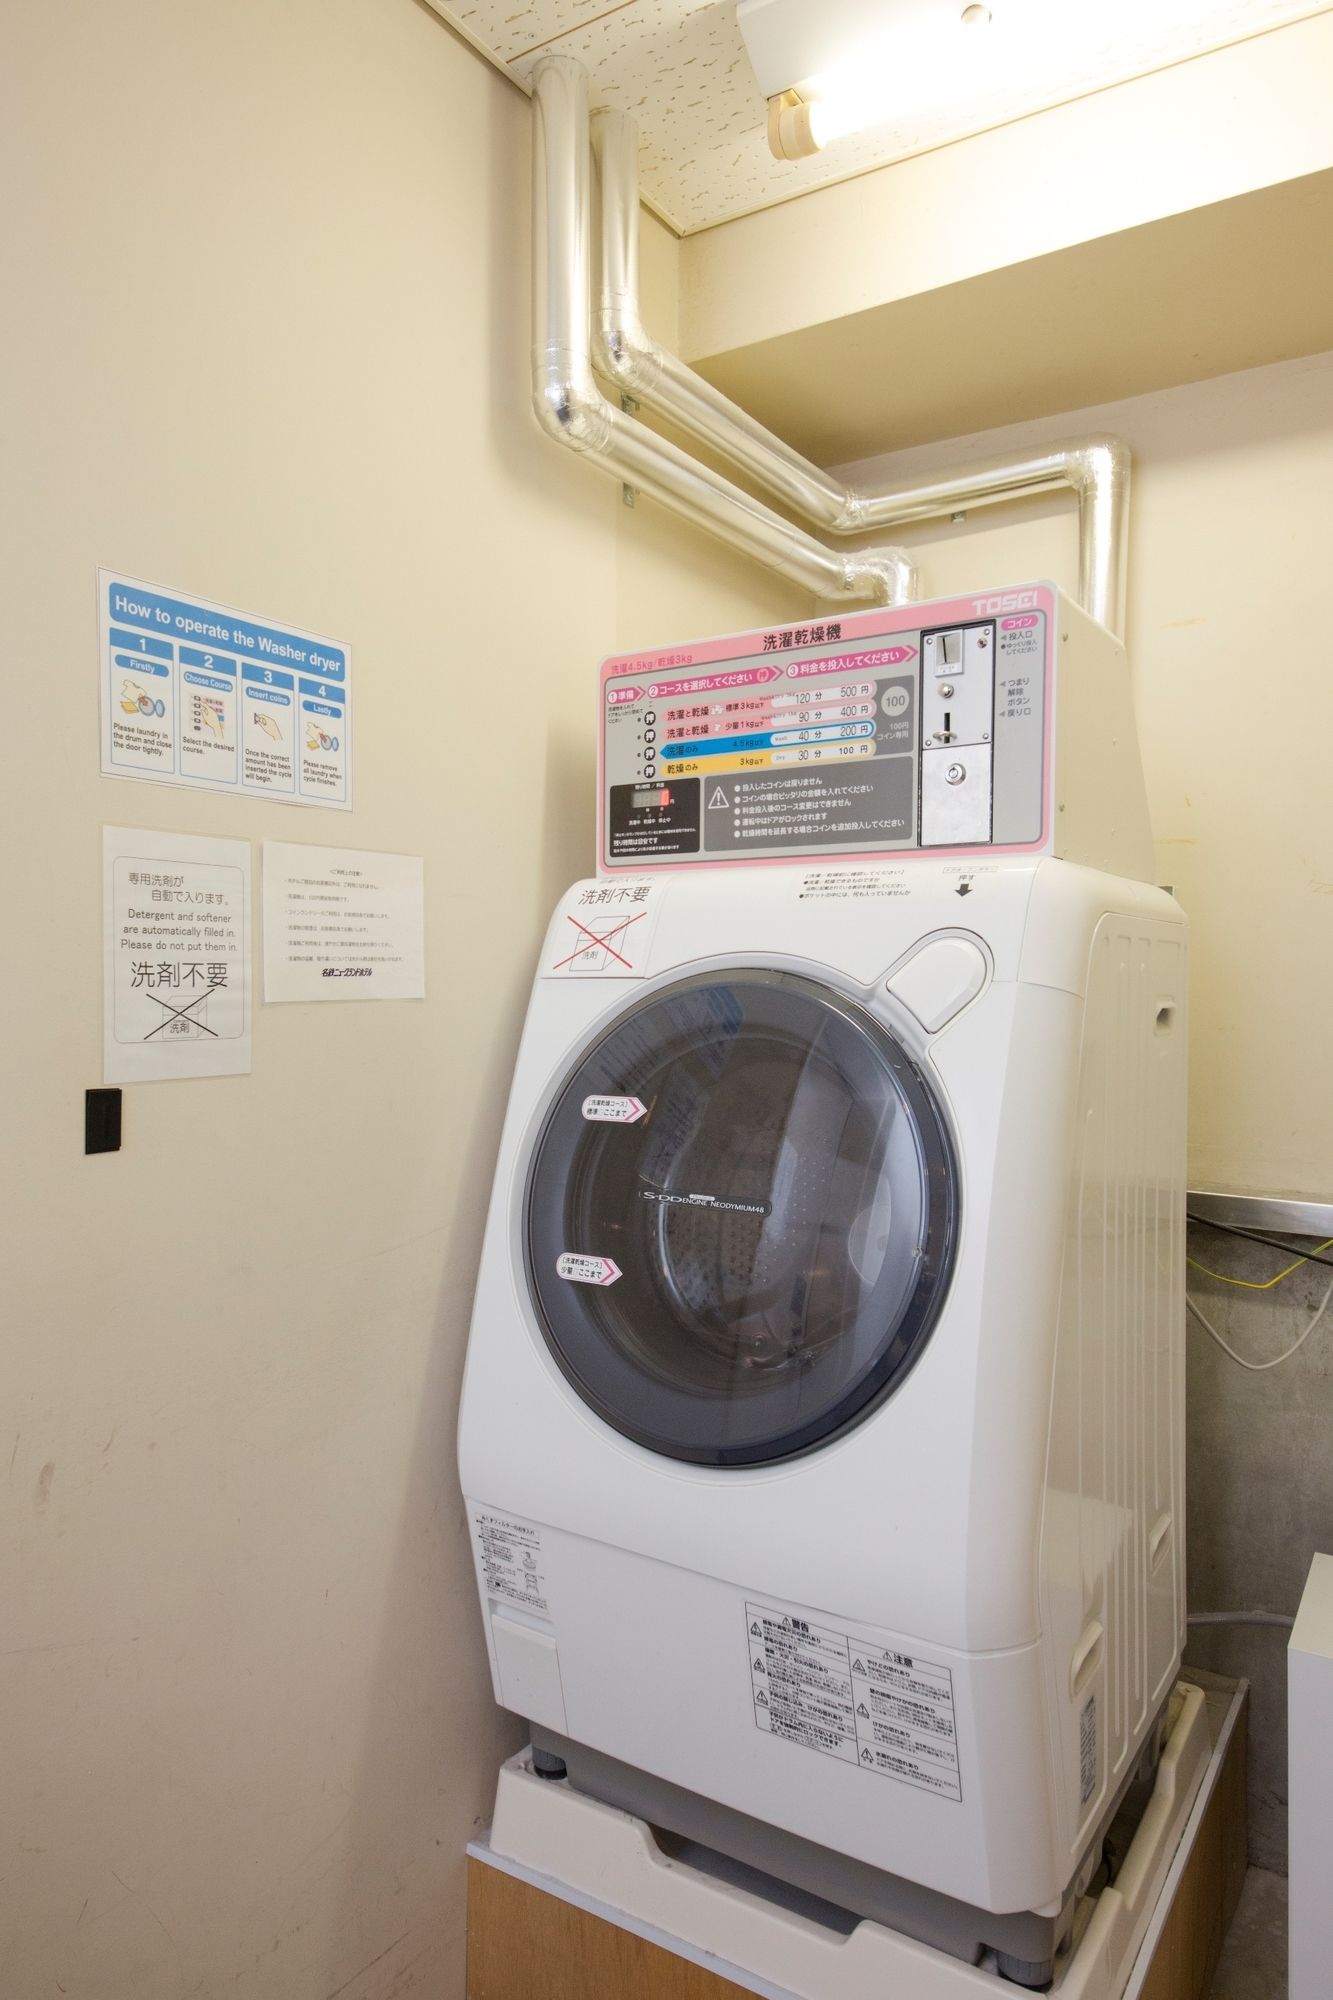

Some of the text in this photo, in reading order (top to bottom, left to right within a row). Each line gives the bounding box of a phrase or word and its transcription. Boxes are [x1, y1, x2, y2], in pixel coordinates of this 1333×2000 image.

[972, 590, 1038, 616] TOSEI
[1008, 618, 1032, 628] コイン
[115, 595, 340, 672] How to operate the Washer dryer
[763, 624, 842, 650] 洗濯乾燥機
[1009, 631, 1032, 641] 投入口
[140, 638, 146, 652] 1
[1007, 646, 1037, 655] してください
[130, 660, 155, 674] Firstly
[204, 655, 214, 668] 2
[800, 650, 899, 674] 料金を投入してください
[184, 672, 232, 692] Choose Course
[264, 671, 272, 683] 3
[660, 674, 752, 694] コースを選択してください
[1008, 677, 1030, 686] つまり
[248, 688, 288, 704] Insert coins
[318, 686, 326, 696] 4
[1008, 688, 1024, 696] 解除
[668, 706, 709, 720] 洗濯と乾燥
[796, 693, 810, 704] 120
[815, 692, 822, 700] 分
[840, 686, 857, 698] 500
[861, 686, 868, 694] 円
[886, 696, 906, 707] 100
[1008, 698, 1030, 706] ボタン
[314, 704, 332, 716] Lastly
[1007, 708, 1031, 717] 戻り口
[668, 724, 709, 739] 洗濯と乾燥
[799, 712, 810, 722] 90
[815, 712, 822, 720] 分
[840, 706, 857, 716] 400
[861, 706, 868, 714] 円
[890, 721, 908, 730] 100円
[114, 722, 134, 733] Please
[136, 728, 160, 740] laundry
[877, 731, 908, 740] コイン専用
[114, 732, 172, 748] the drum and close
[126, 743, 141, 751] door
[182, 736, 234, 752] Select the desired
[668, 745, 698, 756] 洗濯のみ
[798, 730, 809, 741] 40
[840, 726, 856, 736] 200
[861, 725, 868, 734] 円
[245, 748, 260, 757] Once
[270, 753, 290, 762] correct
[668, 764, 698, 774] 乾燥のみ
[798, 750, 808, 760] 30
[814, 750, 821, 758] 分
[861, 745, 868, 753] 円
[246, 758, 290, 770] amount has been
[246, 764, 292, 778] inserted the cycle
[304, 760, 338, 772] Please remove
[310, 768, 328, 778] laundry
[330, 772, 342, 780] when
[742, 778, 822, 792] 投入したコインは戻りません
[742, 799, 852, 814] 料金投入後のコース変更はできません
[742, 813, 827, 826] 運転中はドアがロックされます
[129, 872, 184, 888] 専用洗剤が
[152, 890, 228, 906] 自動で入ります。
[578, 886, 652, 905] 洗剤不要
[128, 908, 232, 923] Detergent and softener
[123, 926, 236, 938] are automatically filled in.
[120, 938, 238, 952] Please do not put them in.
[582, 951, 598, 960] 洗剤
[131, 960, 228, 988] 洗剤不要
[170, 1022, 190, 1034] 洗剤
[710, 1201, 764, 1213] NEODYMIUM48
[792, 1618, 809, 1632] 警告
[894, 1653, 913, 1668] 注意
